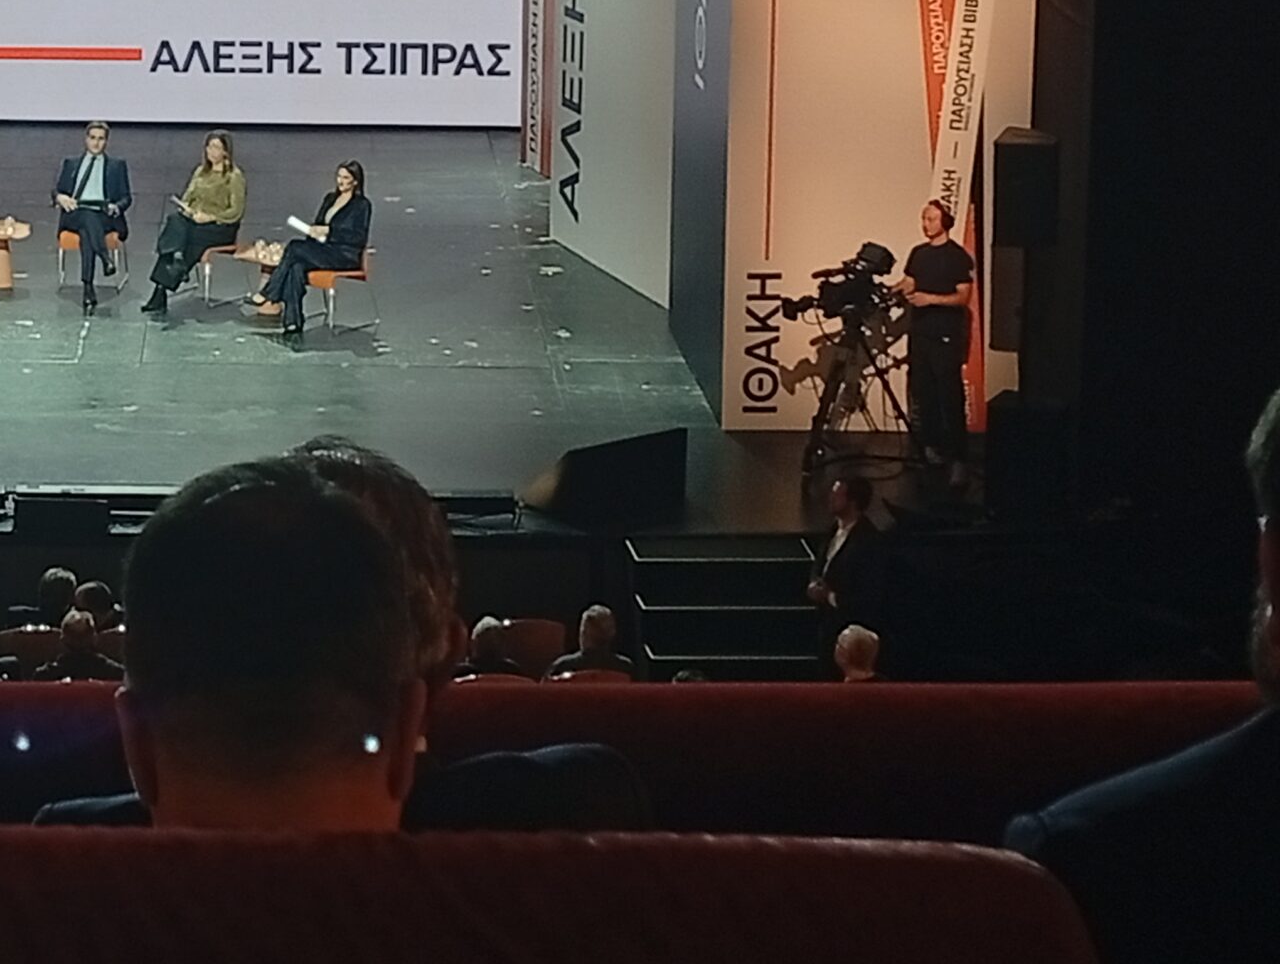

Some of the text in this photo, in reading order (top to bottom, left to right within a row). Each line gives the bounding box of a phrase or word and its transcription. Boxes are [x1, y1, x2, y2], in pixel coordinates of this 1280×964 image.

[149, 40, 322, 77] ΑΛΕΞΗΣ
[336, 40, 512, 78] ΤΣΙΠΡΑΣ
[949, 25, 975, 132] ΠΑΡΟΥΣΙΑΣΗ
[742, 272, 782, 413] ΙΘΑΚΗ
